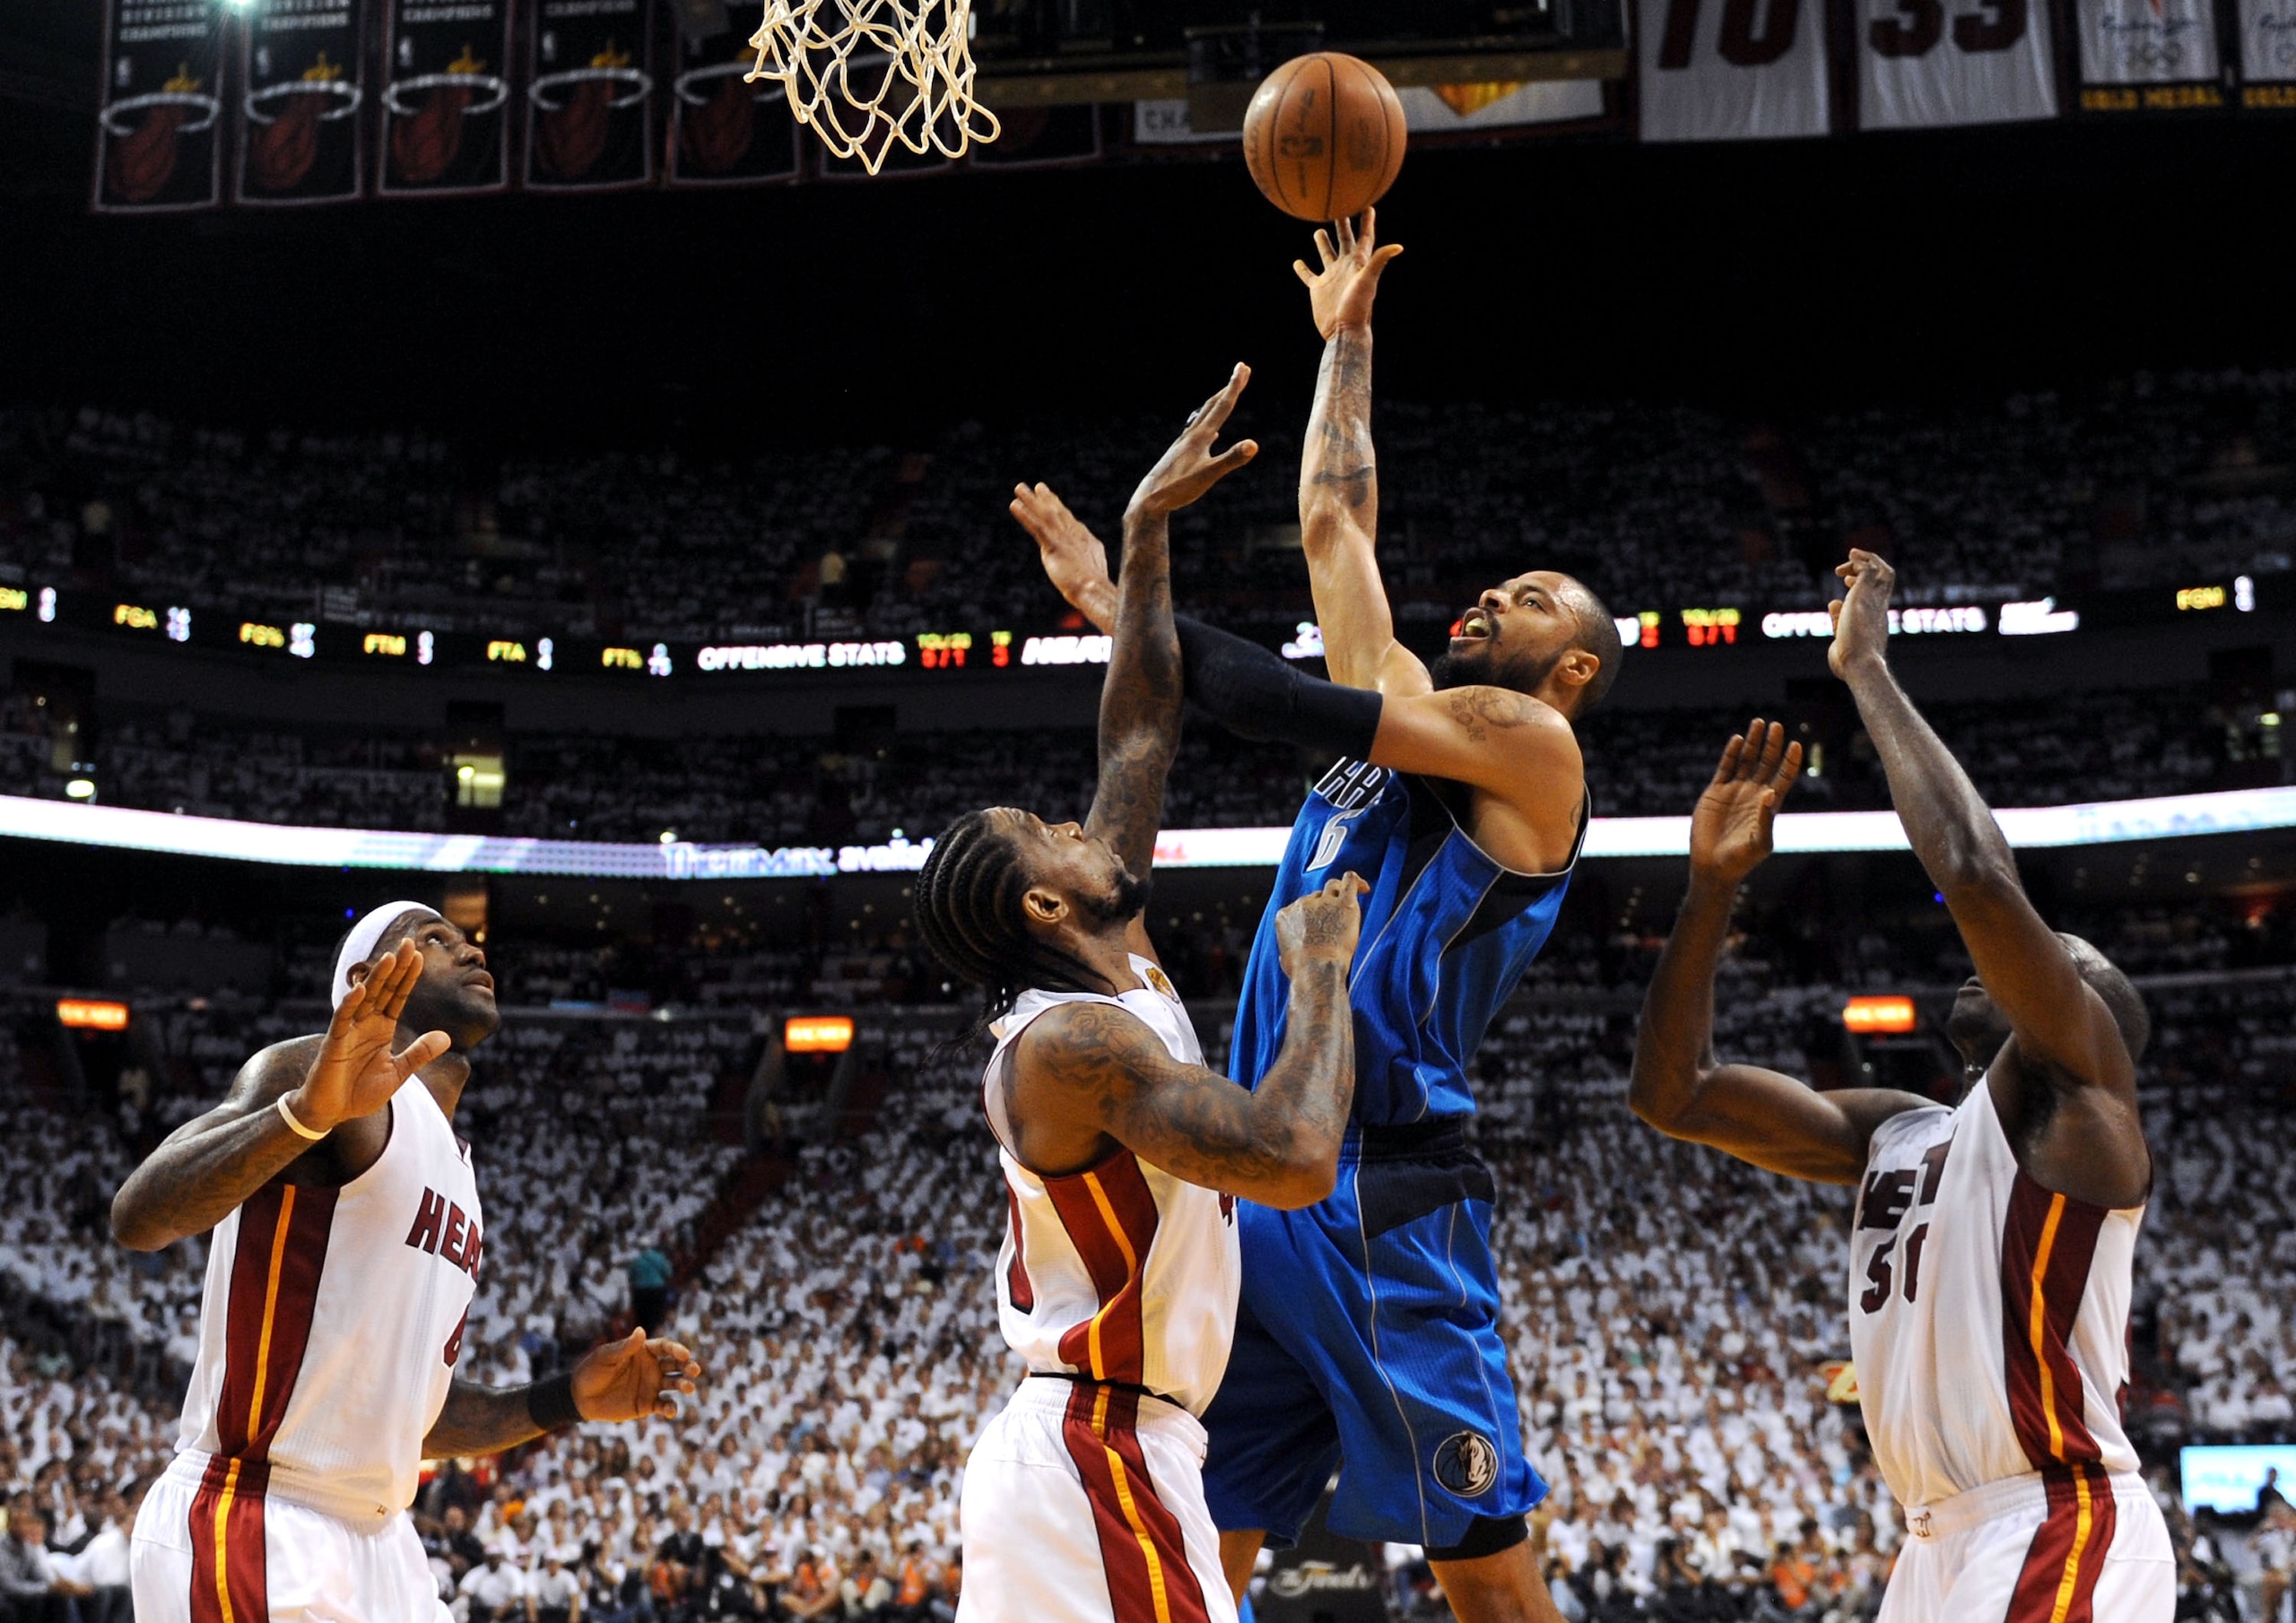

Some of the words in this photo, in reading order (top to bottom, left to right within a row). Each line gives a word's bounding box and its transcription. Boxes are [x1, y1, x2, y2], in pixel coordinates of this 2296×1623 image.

[2176, 586, 2225, 611] FGM
[1901, 606, 1987, 634] STATS
[364, 634, 405, 655] FTM
[487, 641, 526, 663] FTA
[697, 644, 827, 672] OFFENSIVE
[828, 641, 906, 668] STATS
